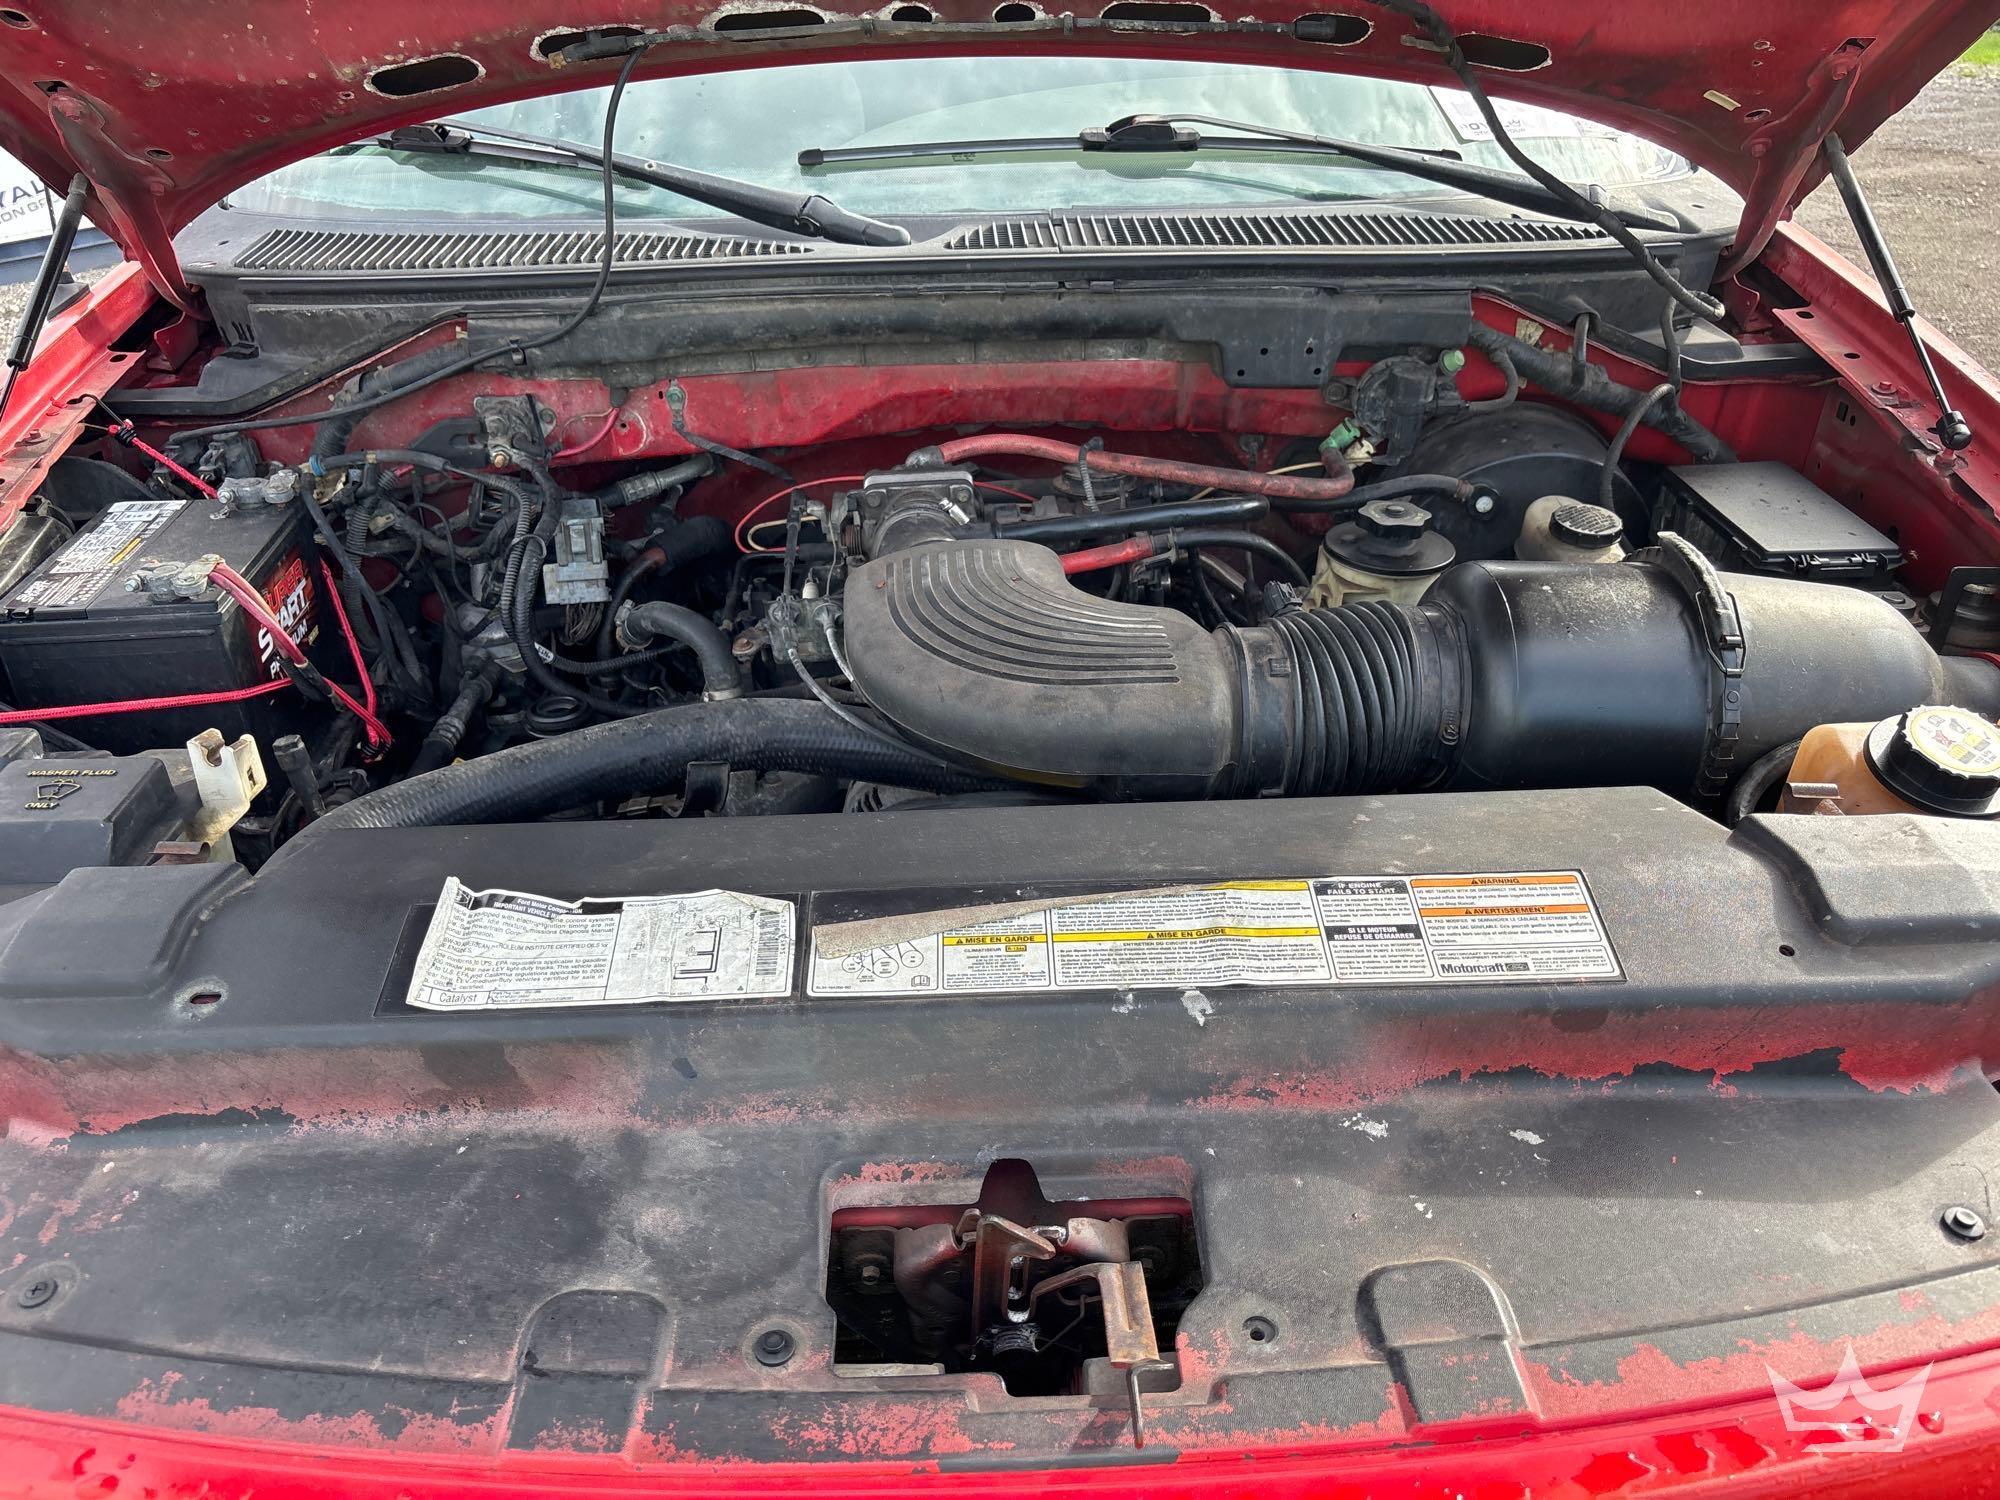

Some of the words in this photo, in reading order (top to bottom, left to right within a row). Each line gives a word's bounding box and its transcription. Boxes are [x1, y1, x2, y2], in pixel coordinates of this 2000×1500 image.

[265, 557, 305, 614] UPER
[258, 577, 307, 664] SART
[26, 768, 80, 777] WASHER
[81, 768, 118, 776] FLUID
[24, 801, 60, 810] ONLY
[1477, 877, 1520, 885] WARNING
[518, 898, 532, 907] Ford
[532, 901, 548, 910] Motor
[493, 902, 527, 916] IMPORTANT
[527, 908, 551, 919] VEHICLE
[1473, 907, 1547, 915] AVERTISSEMENT
[1156, 931, 1179, 939] MISE
[1195, 928, 1227, 938] GARDE
[1374, 932, 1415, 940] DÉMARRER
[965, 936, 988, 944] MISE
[1004, 935, 1035, 943] GARDE
[1440, 962, 1506, 975] Motorcraft
[439, 992, 478, 1005] Catalyst
